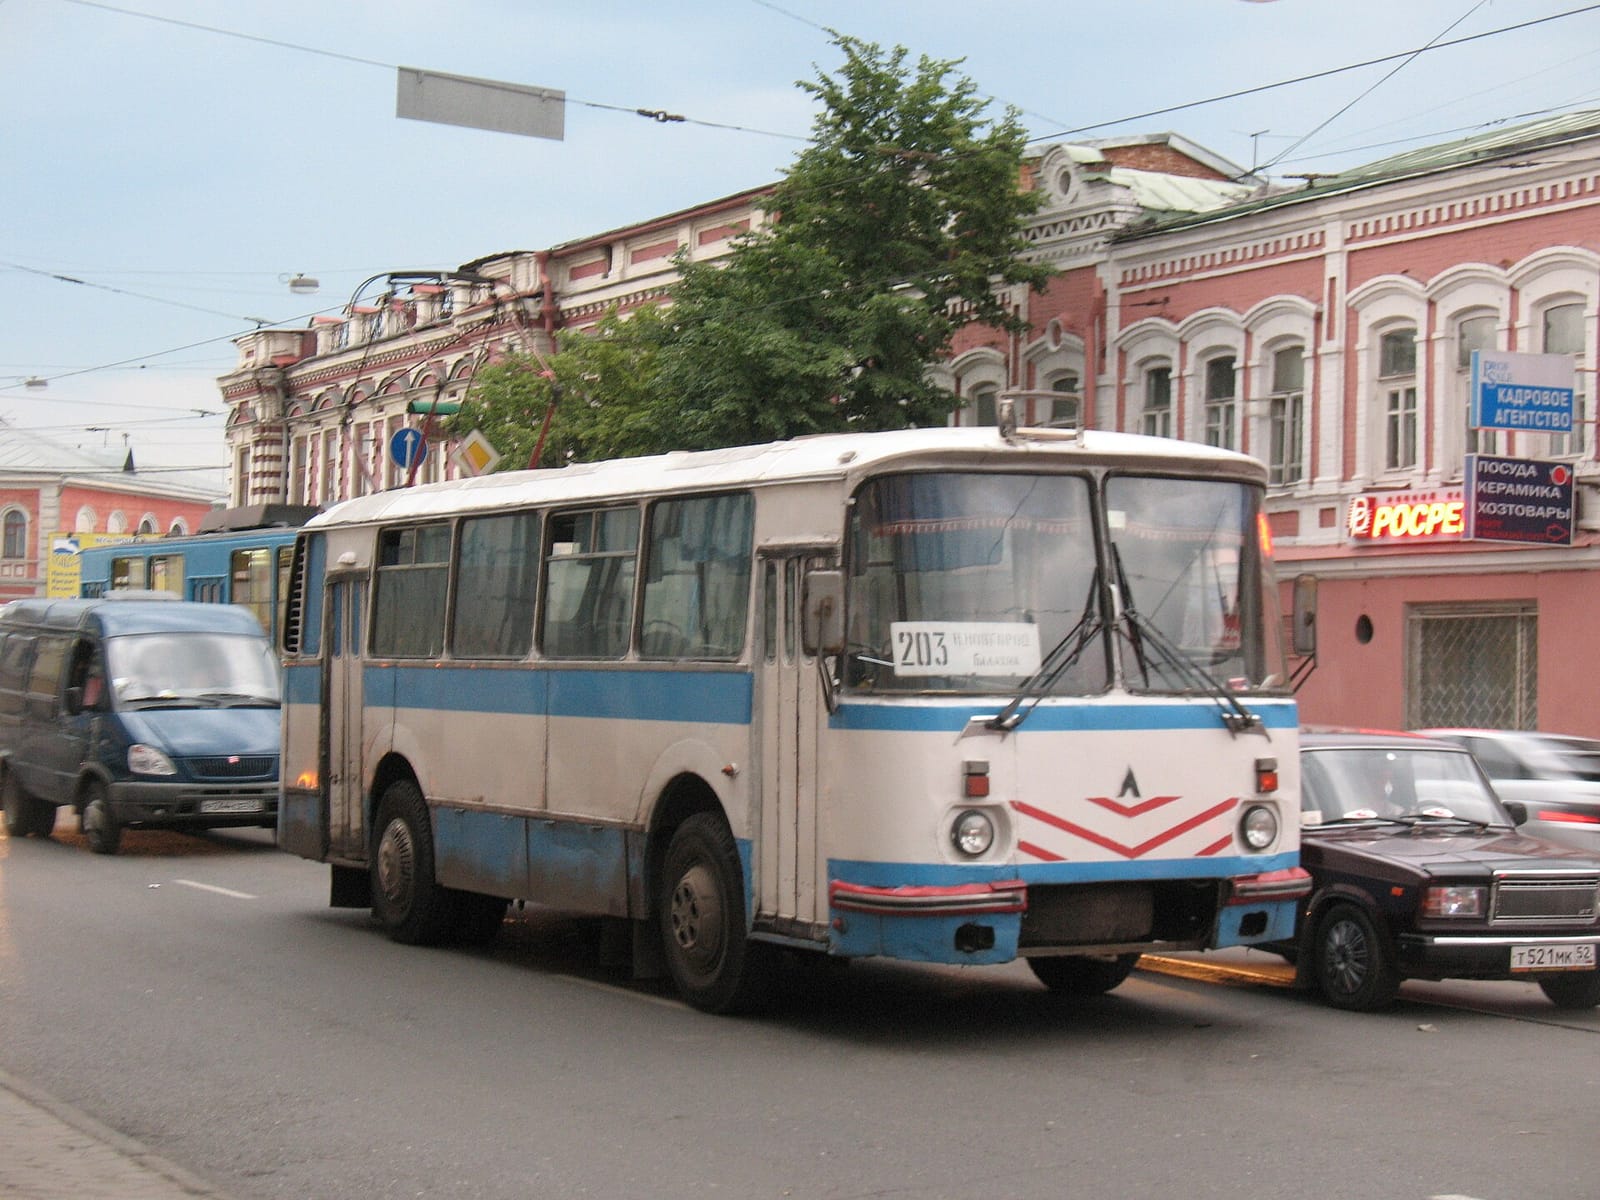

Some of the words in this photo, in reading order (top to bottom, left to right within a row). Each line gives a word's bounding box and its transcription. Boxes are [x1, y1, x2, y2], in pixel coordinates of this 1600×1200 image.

[1497, 388, 1569, 407] КАДРОВОЕ
[1494, 408, 1571, 428] АГЕНТСТВО
[1477, 460, 1538, 478] ПОСУДА
[1477, 482, 1562, 499] КЕРАМИКА
[1371, 502, 1465, 537] РОСРЕ
[1477, 501, 1571, 520] ХОЗТОВАРЫ
[899, 632, 948, 666] 203
